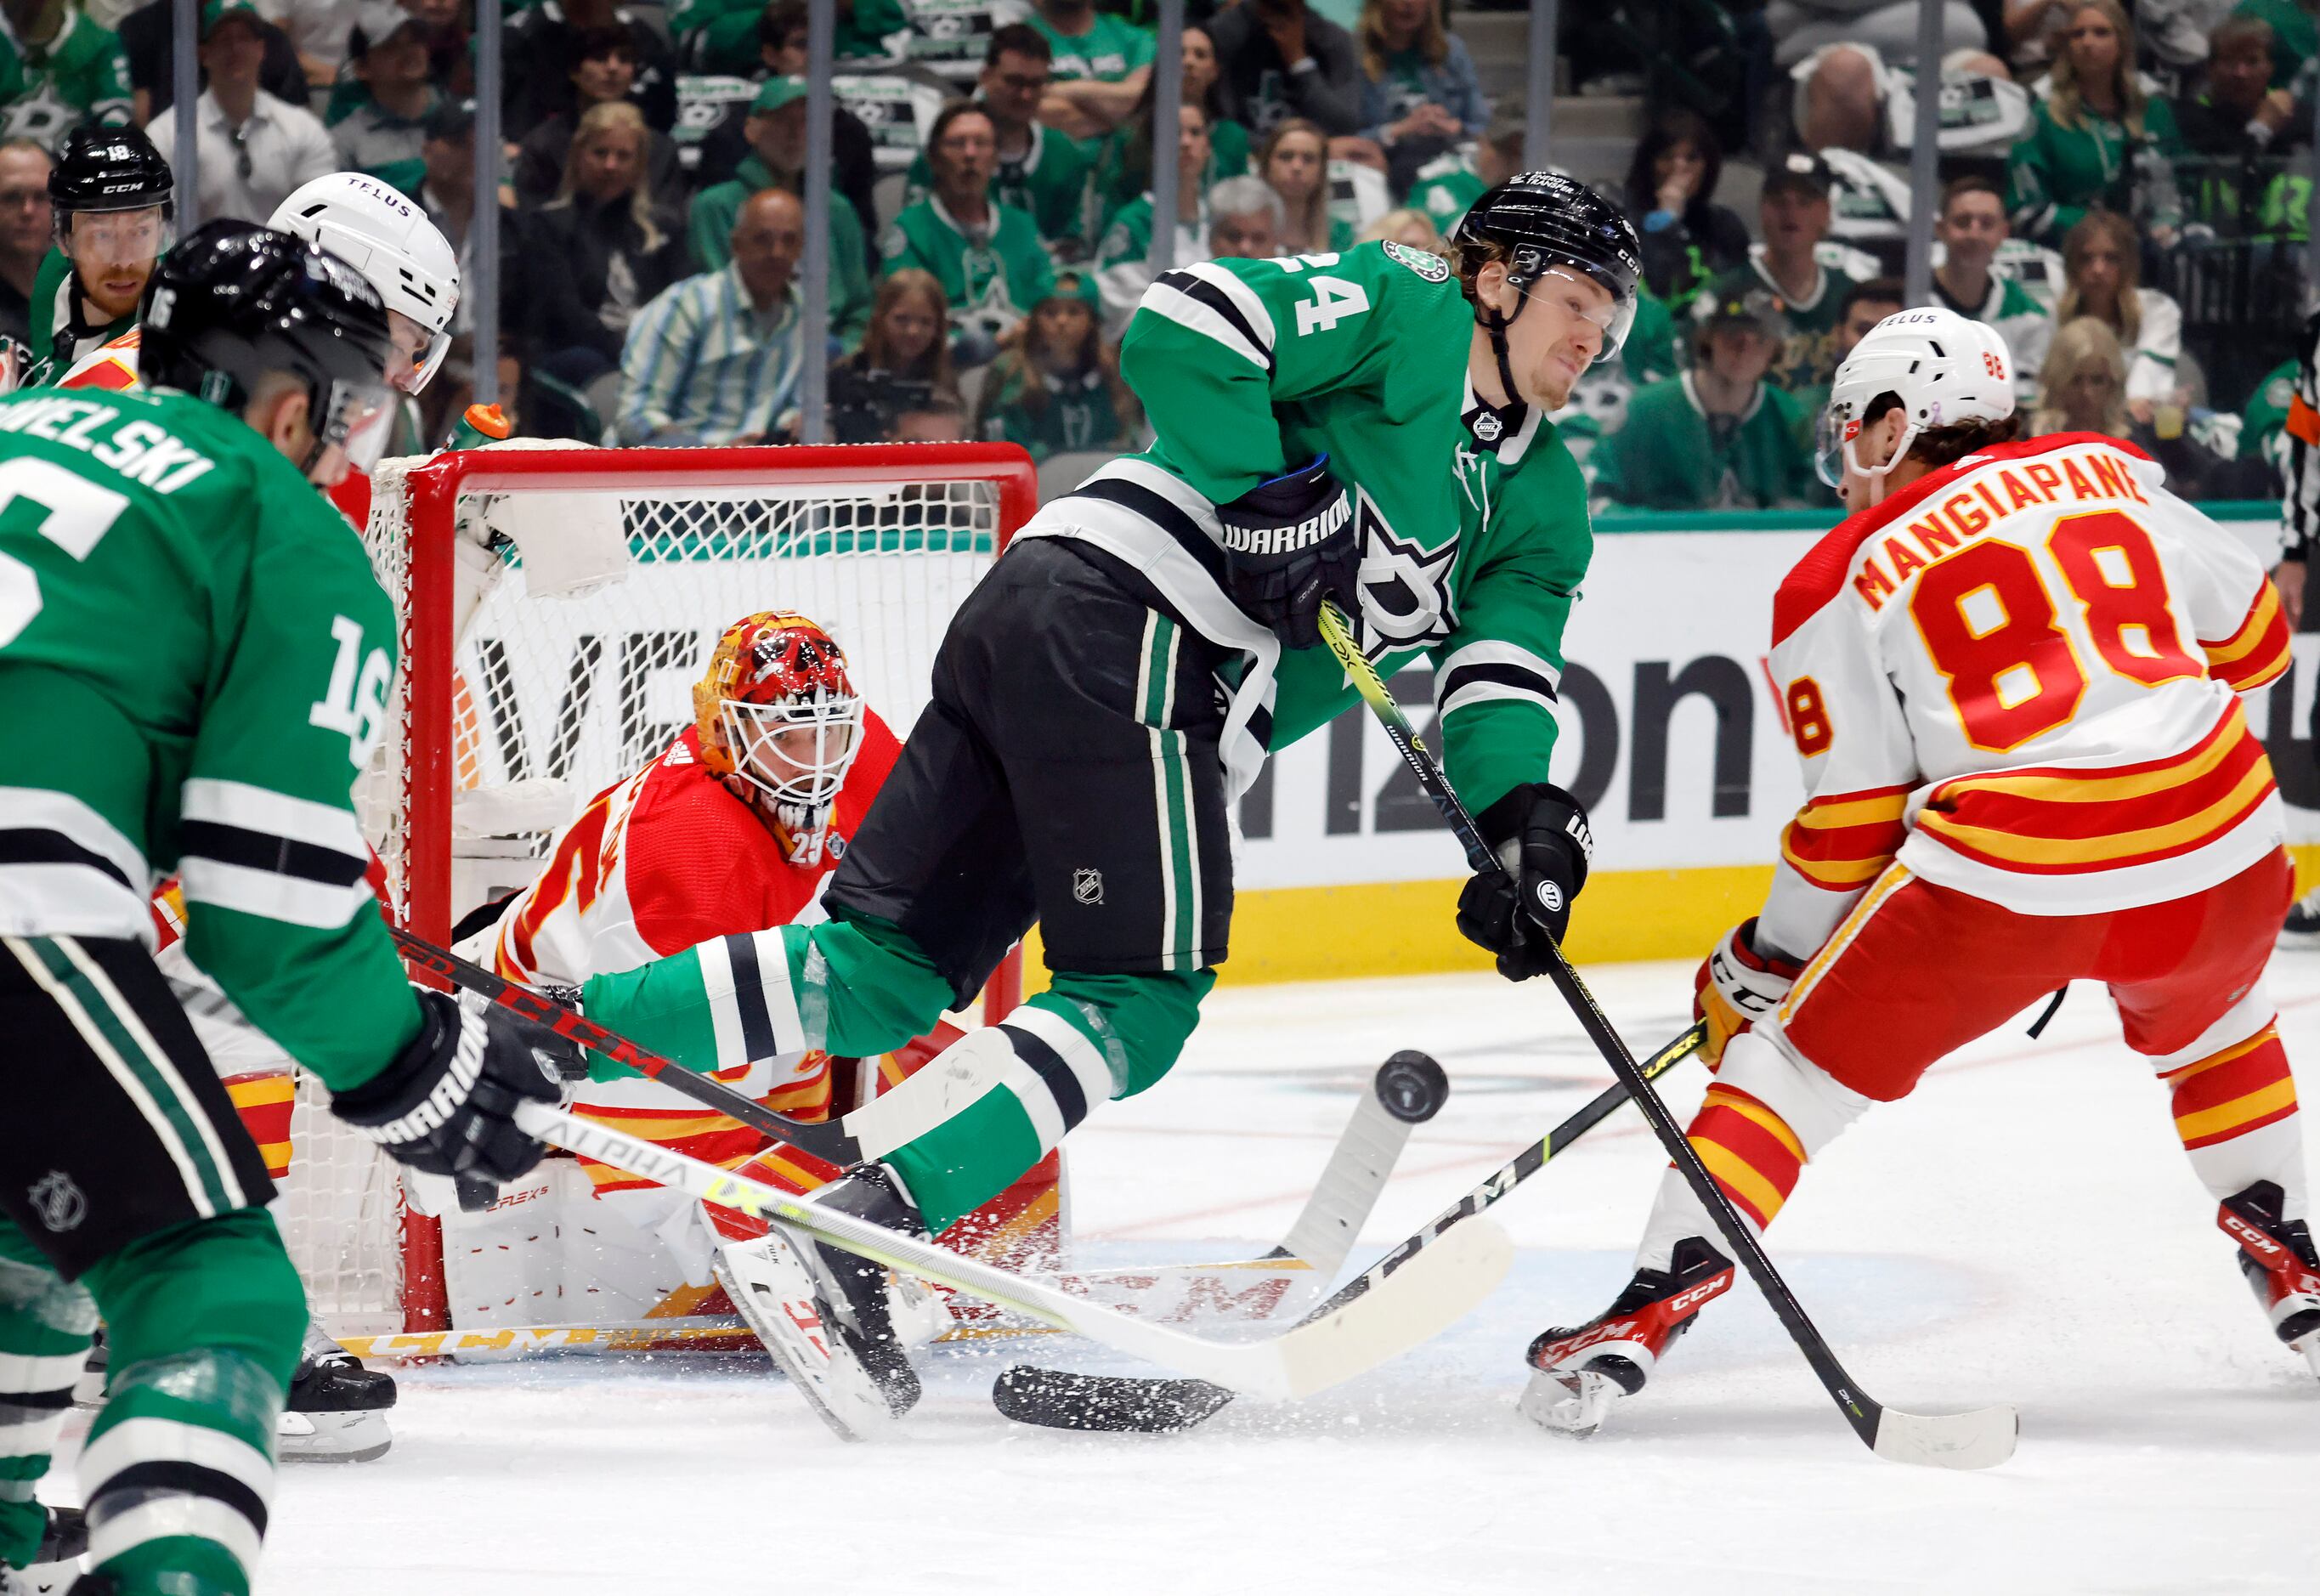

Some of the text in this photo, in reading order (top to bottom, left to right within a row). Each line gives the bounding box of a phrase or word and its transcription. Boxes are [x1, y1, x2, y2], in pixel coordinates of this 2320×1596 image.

[106, 144, 130, 161] 18
[102, 181, 145, 195] CCM
[347, 178, 412, 218] TELUS
[1526, 178, 1575, 195] TRANSFER
[1530, 173, 1570, 185] ENERGY
[1617, 248, 1641, 276] CCM
[1876, 314, 1938, 329] TELUS
[1224, 488, 1353, 556] WARRIOR
[1852, 453, 2152, 613] MANGIAPANE
[1908, 507, 2210, 755] 88
[308, 613, 393, 772] 16
[662, 740, 684, 767] adidas
[1385, 723, 1429, 784] WARRIOR
[789, 830, 824, 863] 25
[494, 982, 671, 1079] CCM
[1642, 1031, 1701, 1079] UPER
[542, 1119, 688, 1188] ALPHA
[2224, 1216, 2281, 1254] CCM
[1670, 1275, 1727, 1311] CCM
[367, 1329, 573, 1356] CCM
[1542, 1321, 1640, 1364] CCM
